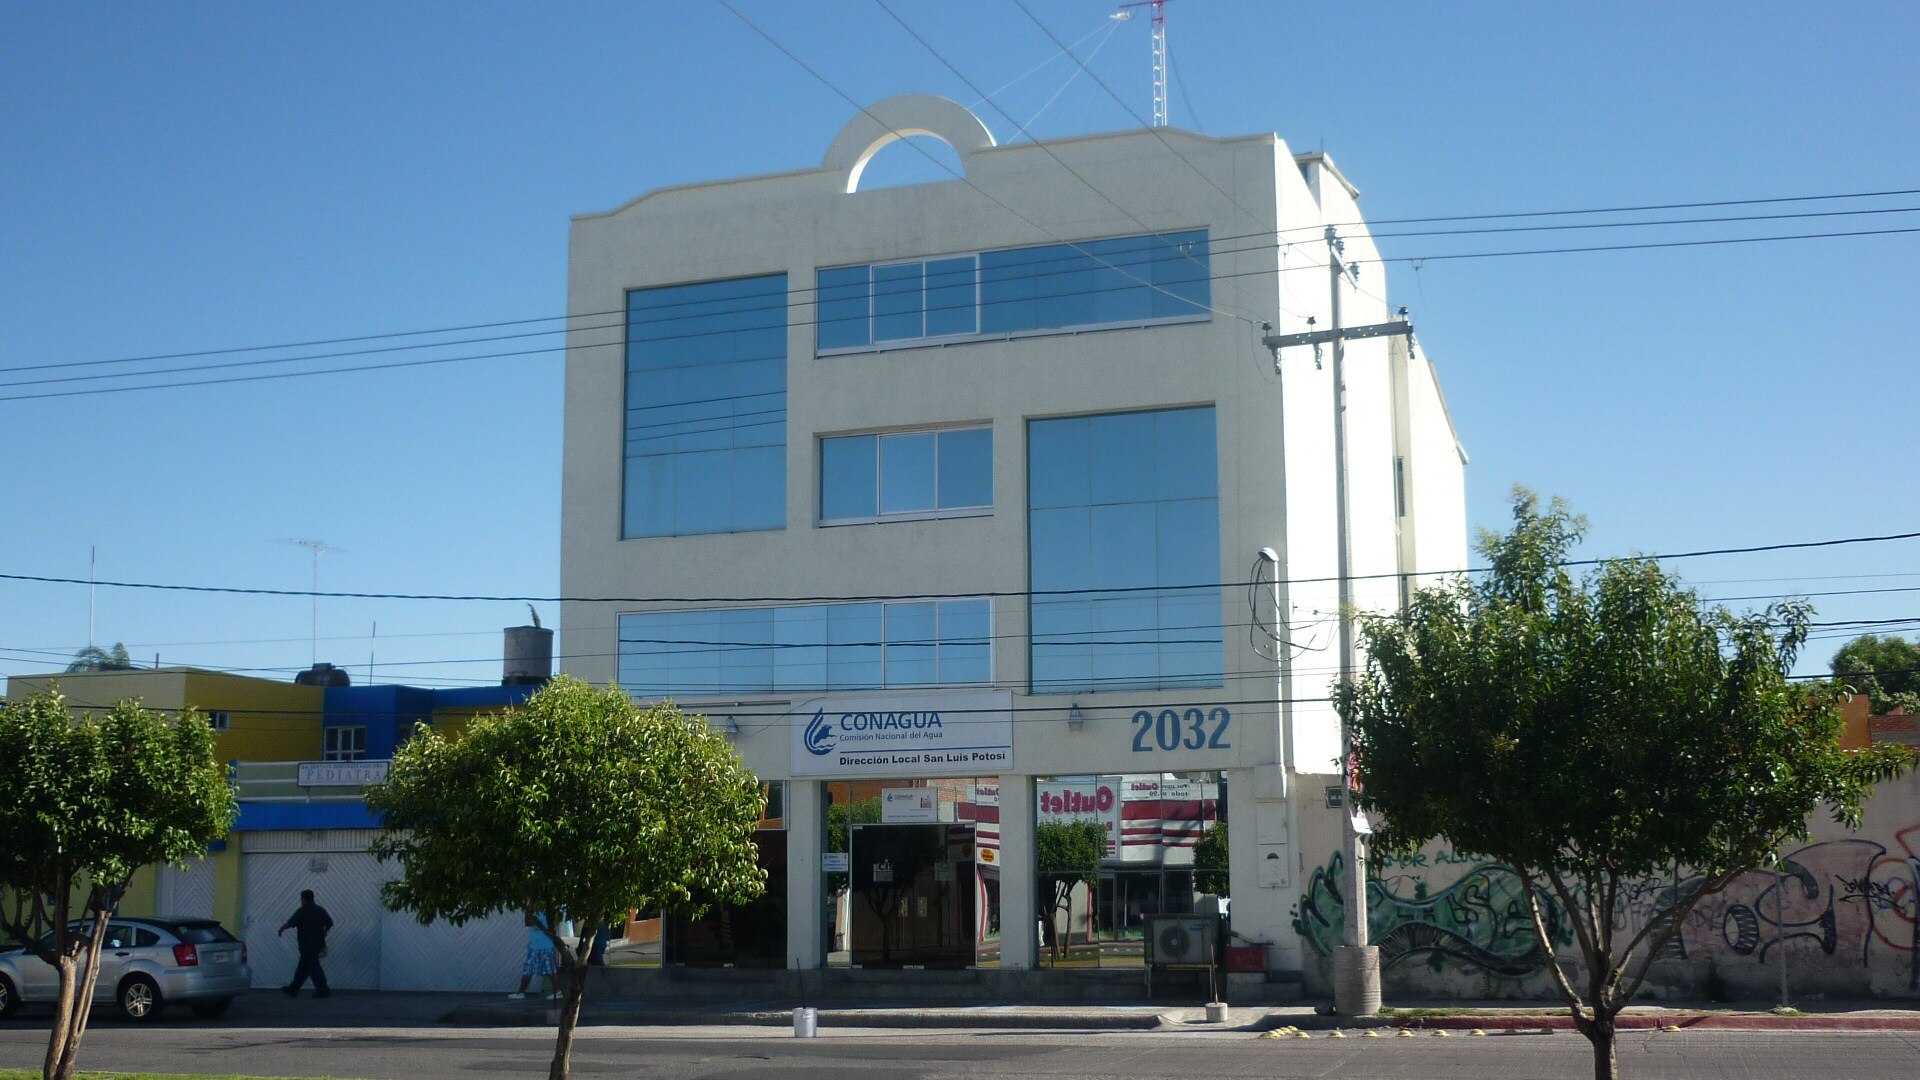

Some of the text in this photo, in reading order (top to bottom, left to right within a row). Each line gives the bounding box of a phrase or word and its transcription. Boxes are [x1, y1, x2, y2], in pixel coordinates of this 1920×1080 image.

[840, 711, 943, 731] CONAGUA
[1131, 707, 1231, 752] 2032
[839, 731, 943, 742] Comisión Nacional del Agua
[839, 755, 889, 765] Dirección
[892, 754, 921, 764] Local
[924, 754, 943, 763] San
[946, 752, 969, 762] Luis
[307, 769, 381, 780] PEDIATRA
